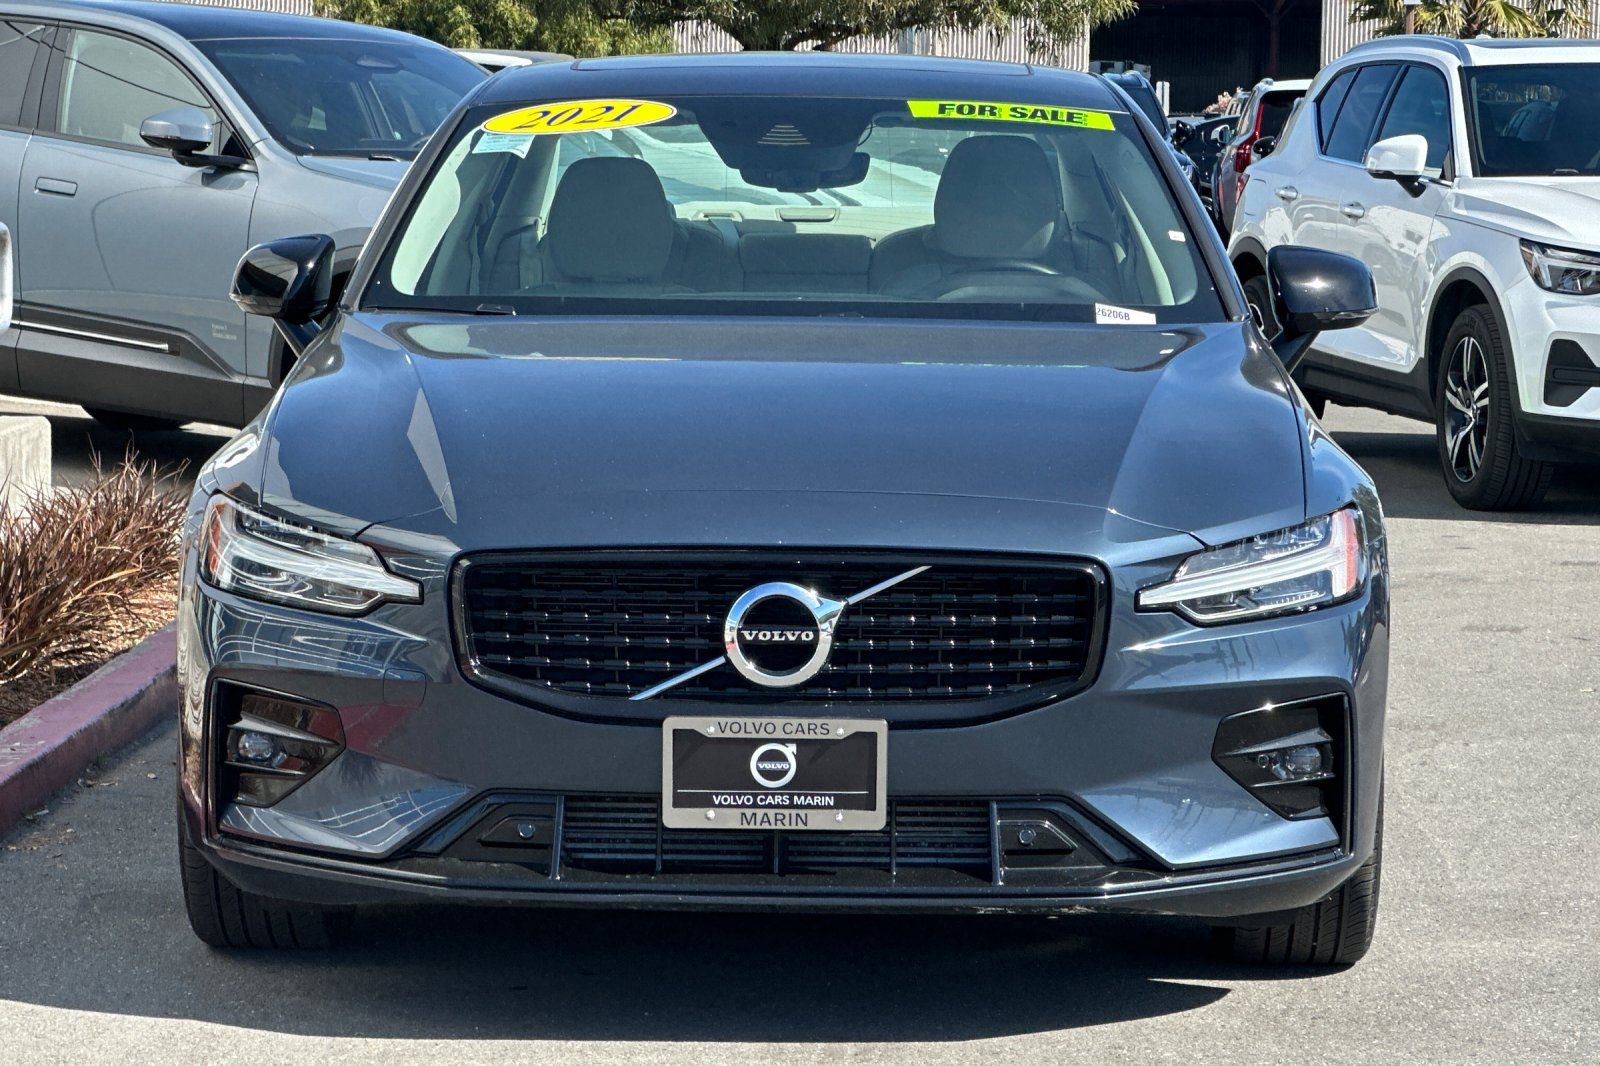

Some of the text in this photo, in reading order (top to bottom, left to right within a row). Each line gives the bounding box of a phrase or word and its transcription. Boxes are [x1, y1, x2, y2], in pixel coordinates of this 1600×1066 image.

[511, 104, 643, 130] 2021
[938, 103, 1084, 124] FOR SALE
[741, 630, 814, 641] VOLVO
[718, 721, 830, 736] VOLVO CARS
[712, 795, 834, 806] VOLVO CARS MARIN
[740, 812, 808, 827] MARIN
